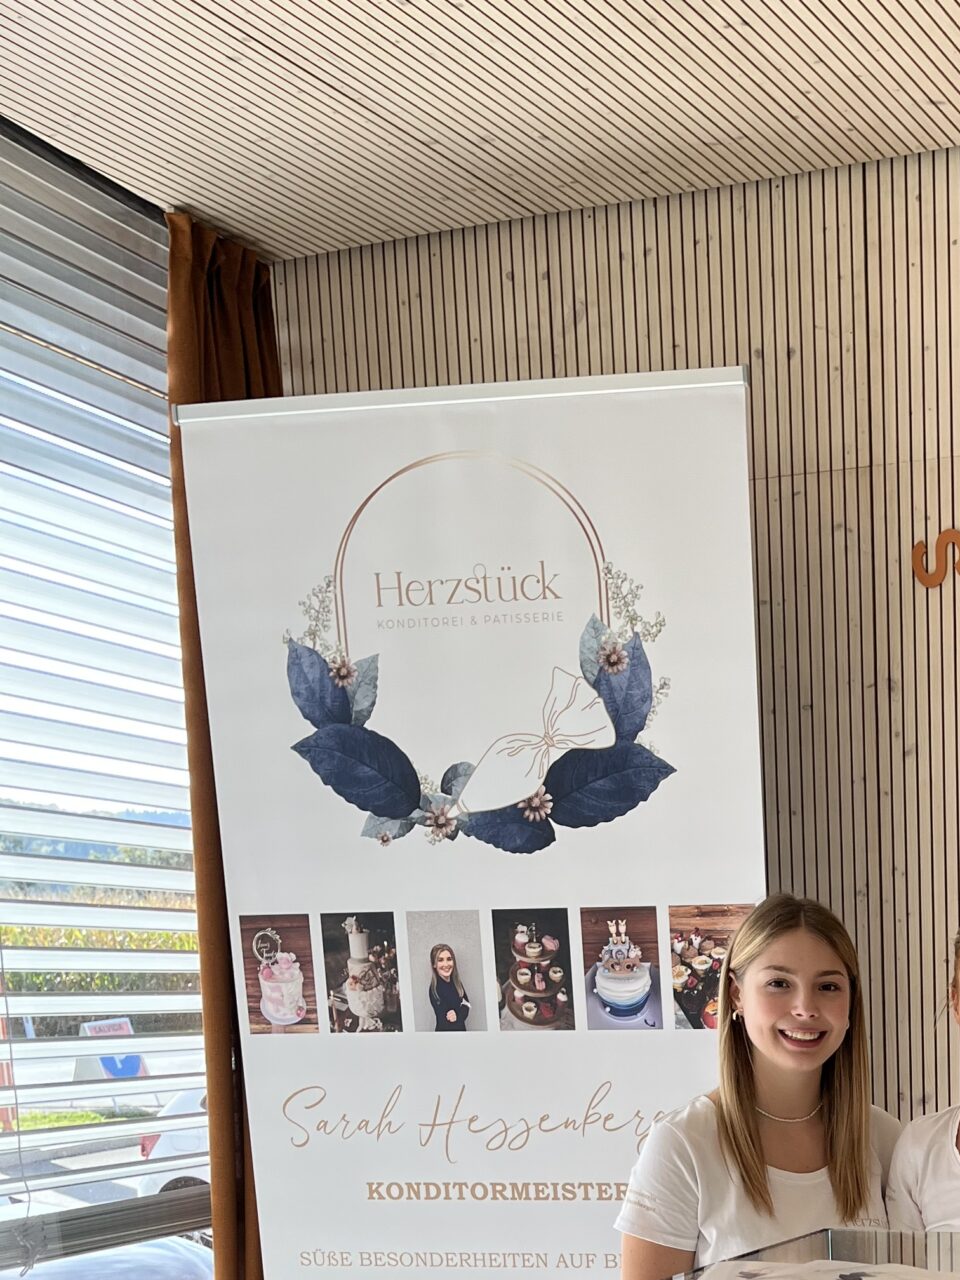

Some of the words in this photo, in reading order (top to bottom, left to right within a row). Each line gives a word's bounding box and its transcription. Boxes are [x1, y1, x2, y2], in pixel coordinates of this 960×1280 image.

[373, 560, 564, 608] Herzstück
[376, 616, 464, 631] KONDITOREI
[470, 615, 478, 626] &
[483, 610, 565, 625] PATISSERIE
[282, 1083, 406, 1148] Sarah
[359, 1251, 548, 1269] BESONDERHEITEN
[556, 1252, 598, 1269] AUF
[605, 1253, 622, 1269] B
